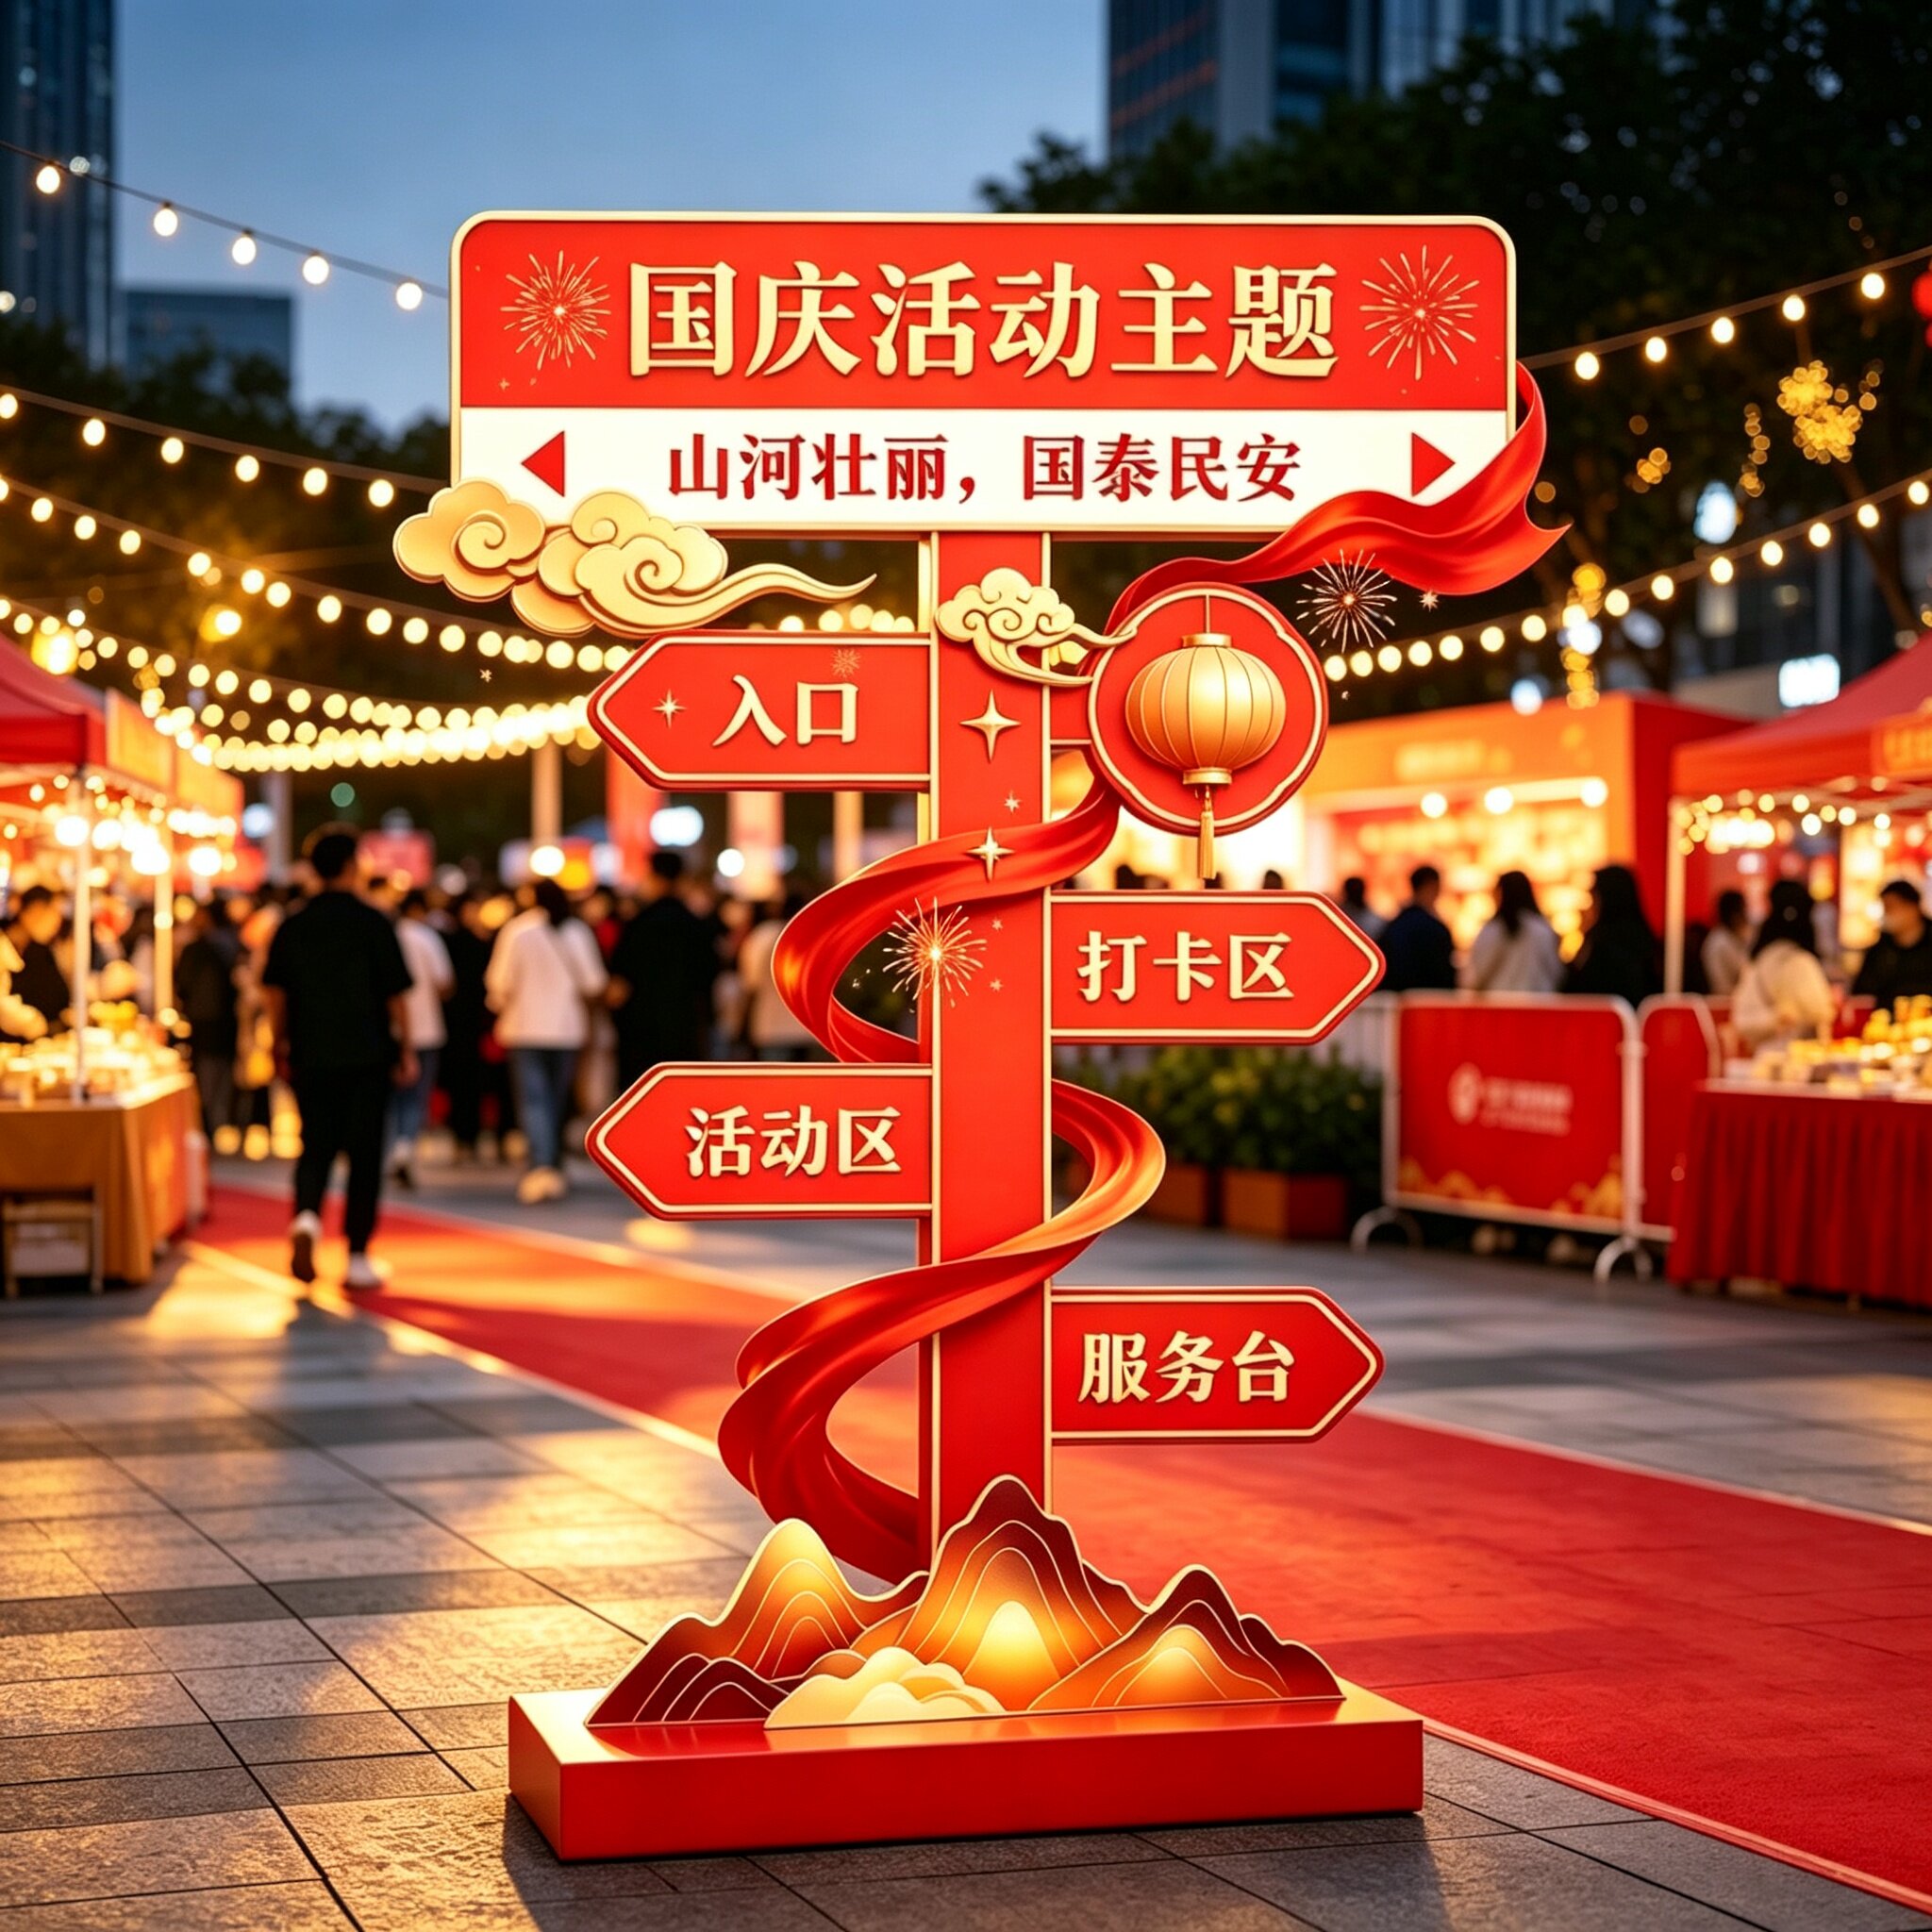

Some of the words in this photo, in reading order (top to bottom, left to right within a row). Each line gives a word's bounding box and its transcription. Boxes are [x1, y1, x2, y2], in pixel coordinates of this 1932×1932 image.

[629, 260, 1340, 378] 国庆活动主题
[669, 434, 1301, 504] 山河壮丽，国泰民安
[713, 675, 858, 746] 入口
[1077, 930, 1294, 1002] 打卡区
[685, 1105, 901, 1177] 活动区
[1078, 1330, 1294, 1403] 服务台
